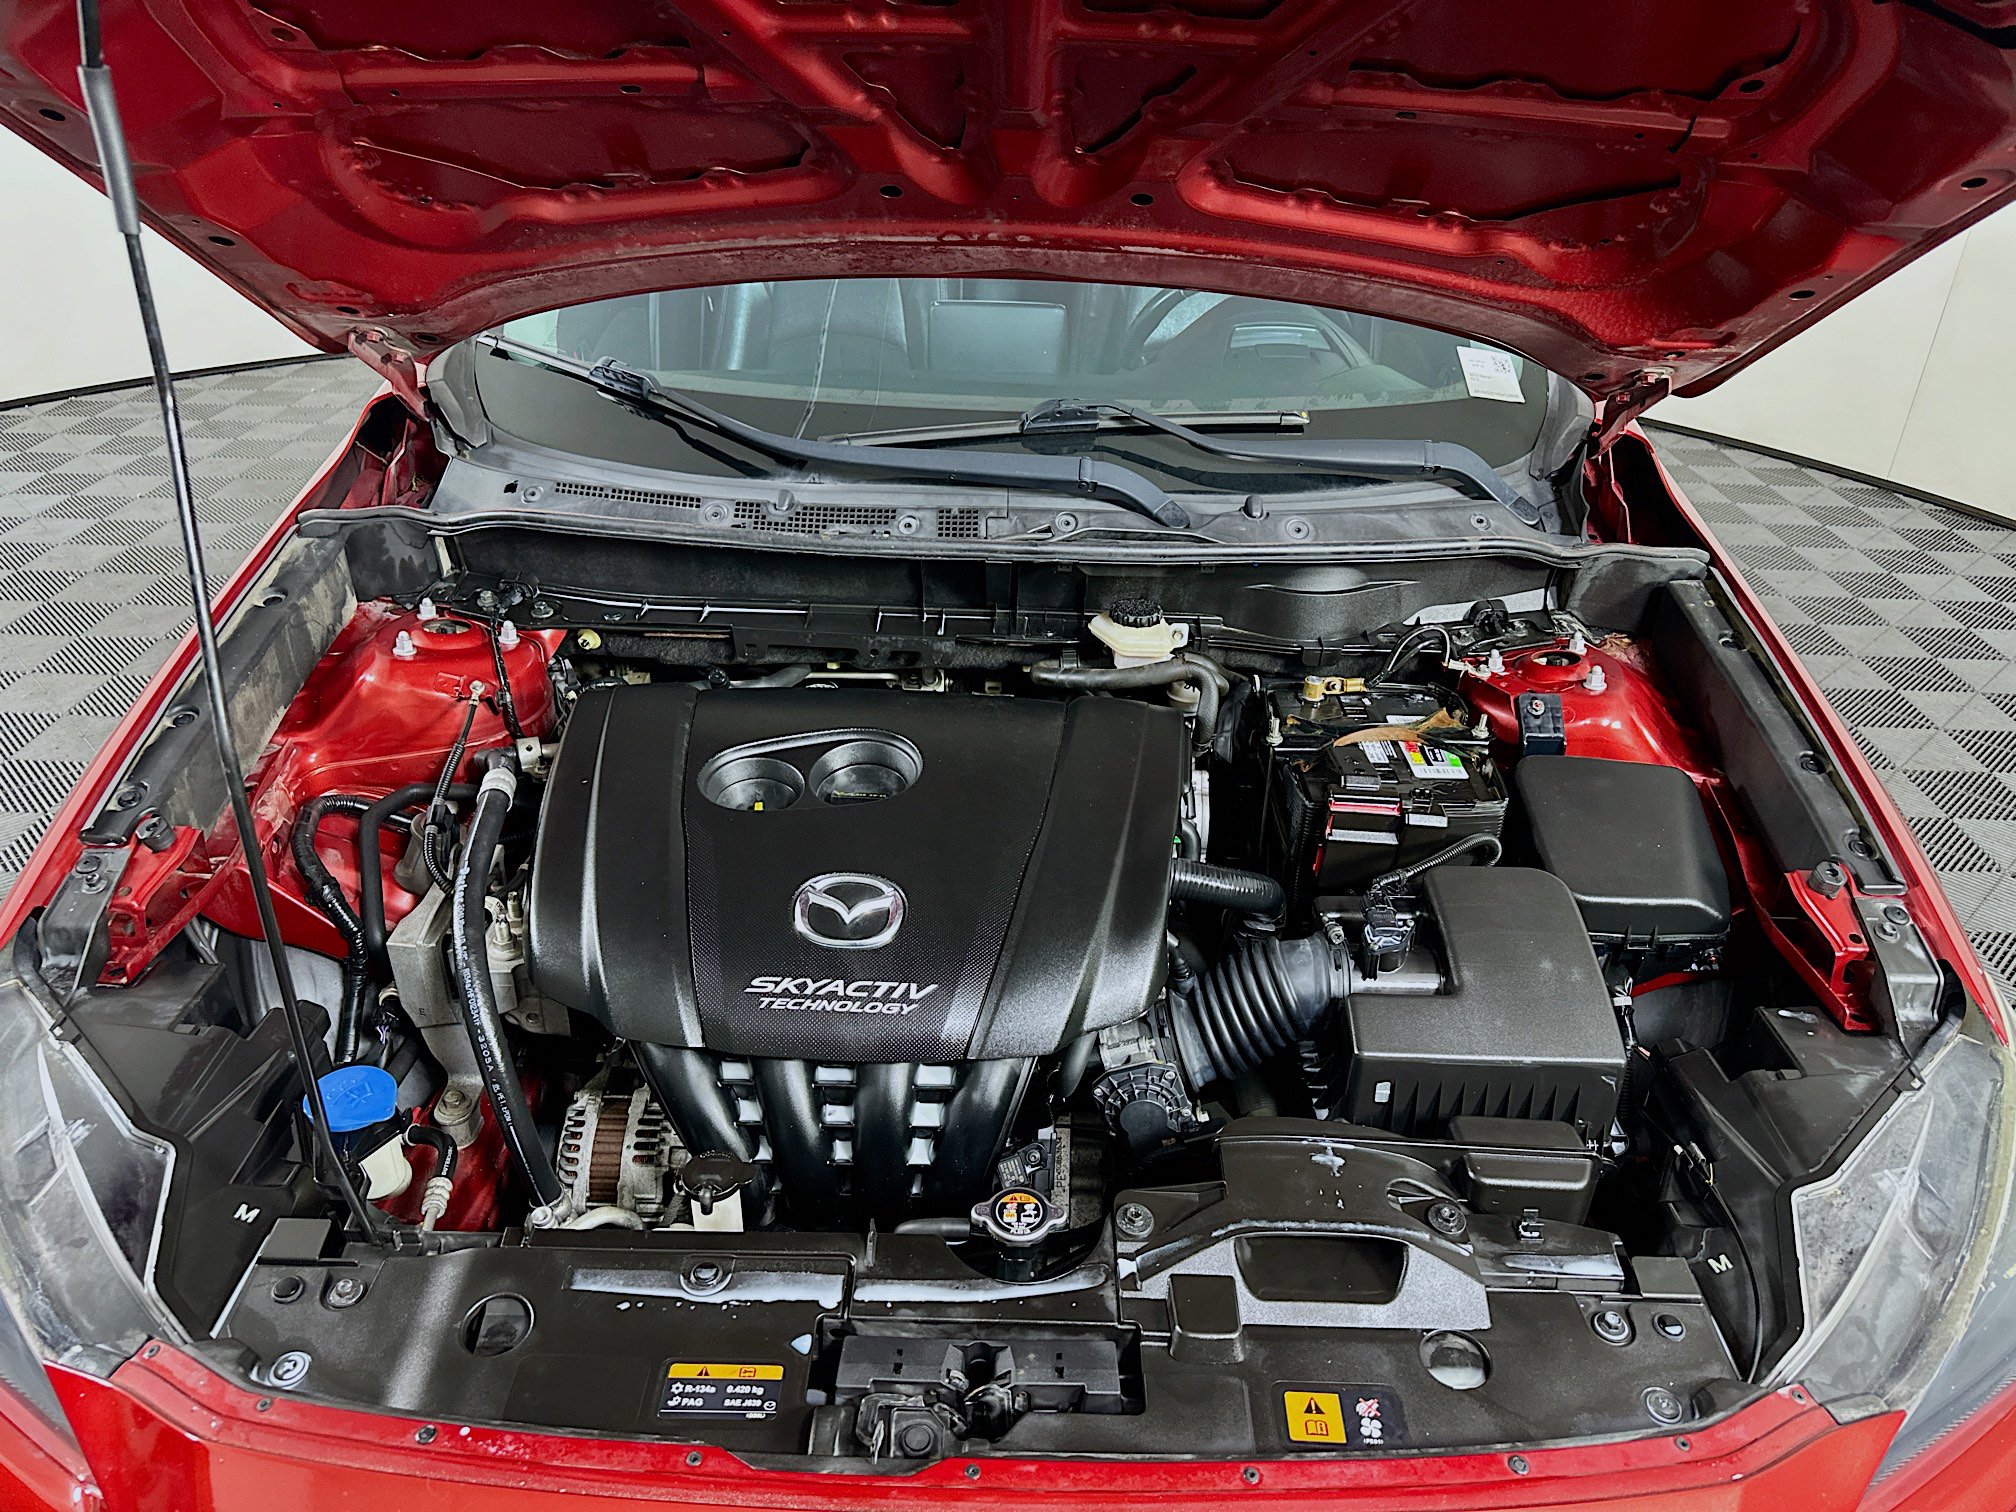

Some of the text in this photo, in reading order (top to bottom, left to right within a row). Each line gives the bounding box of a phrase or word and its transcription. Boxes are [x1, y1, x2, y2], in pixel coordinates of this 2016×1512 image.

[744, 976, 938, 1000] SKYACTIV
[758, 997, 919, 1015] TECHNOLOGY
[684, 1384, 717, 1394] R-134a
[751, 1385, 765, 1396] kg
[681, 1397, 703, 1407] PAG
[723, 1398, 742, 1407] SAE
